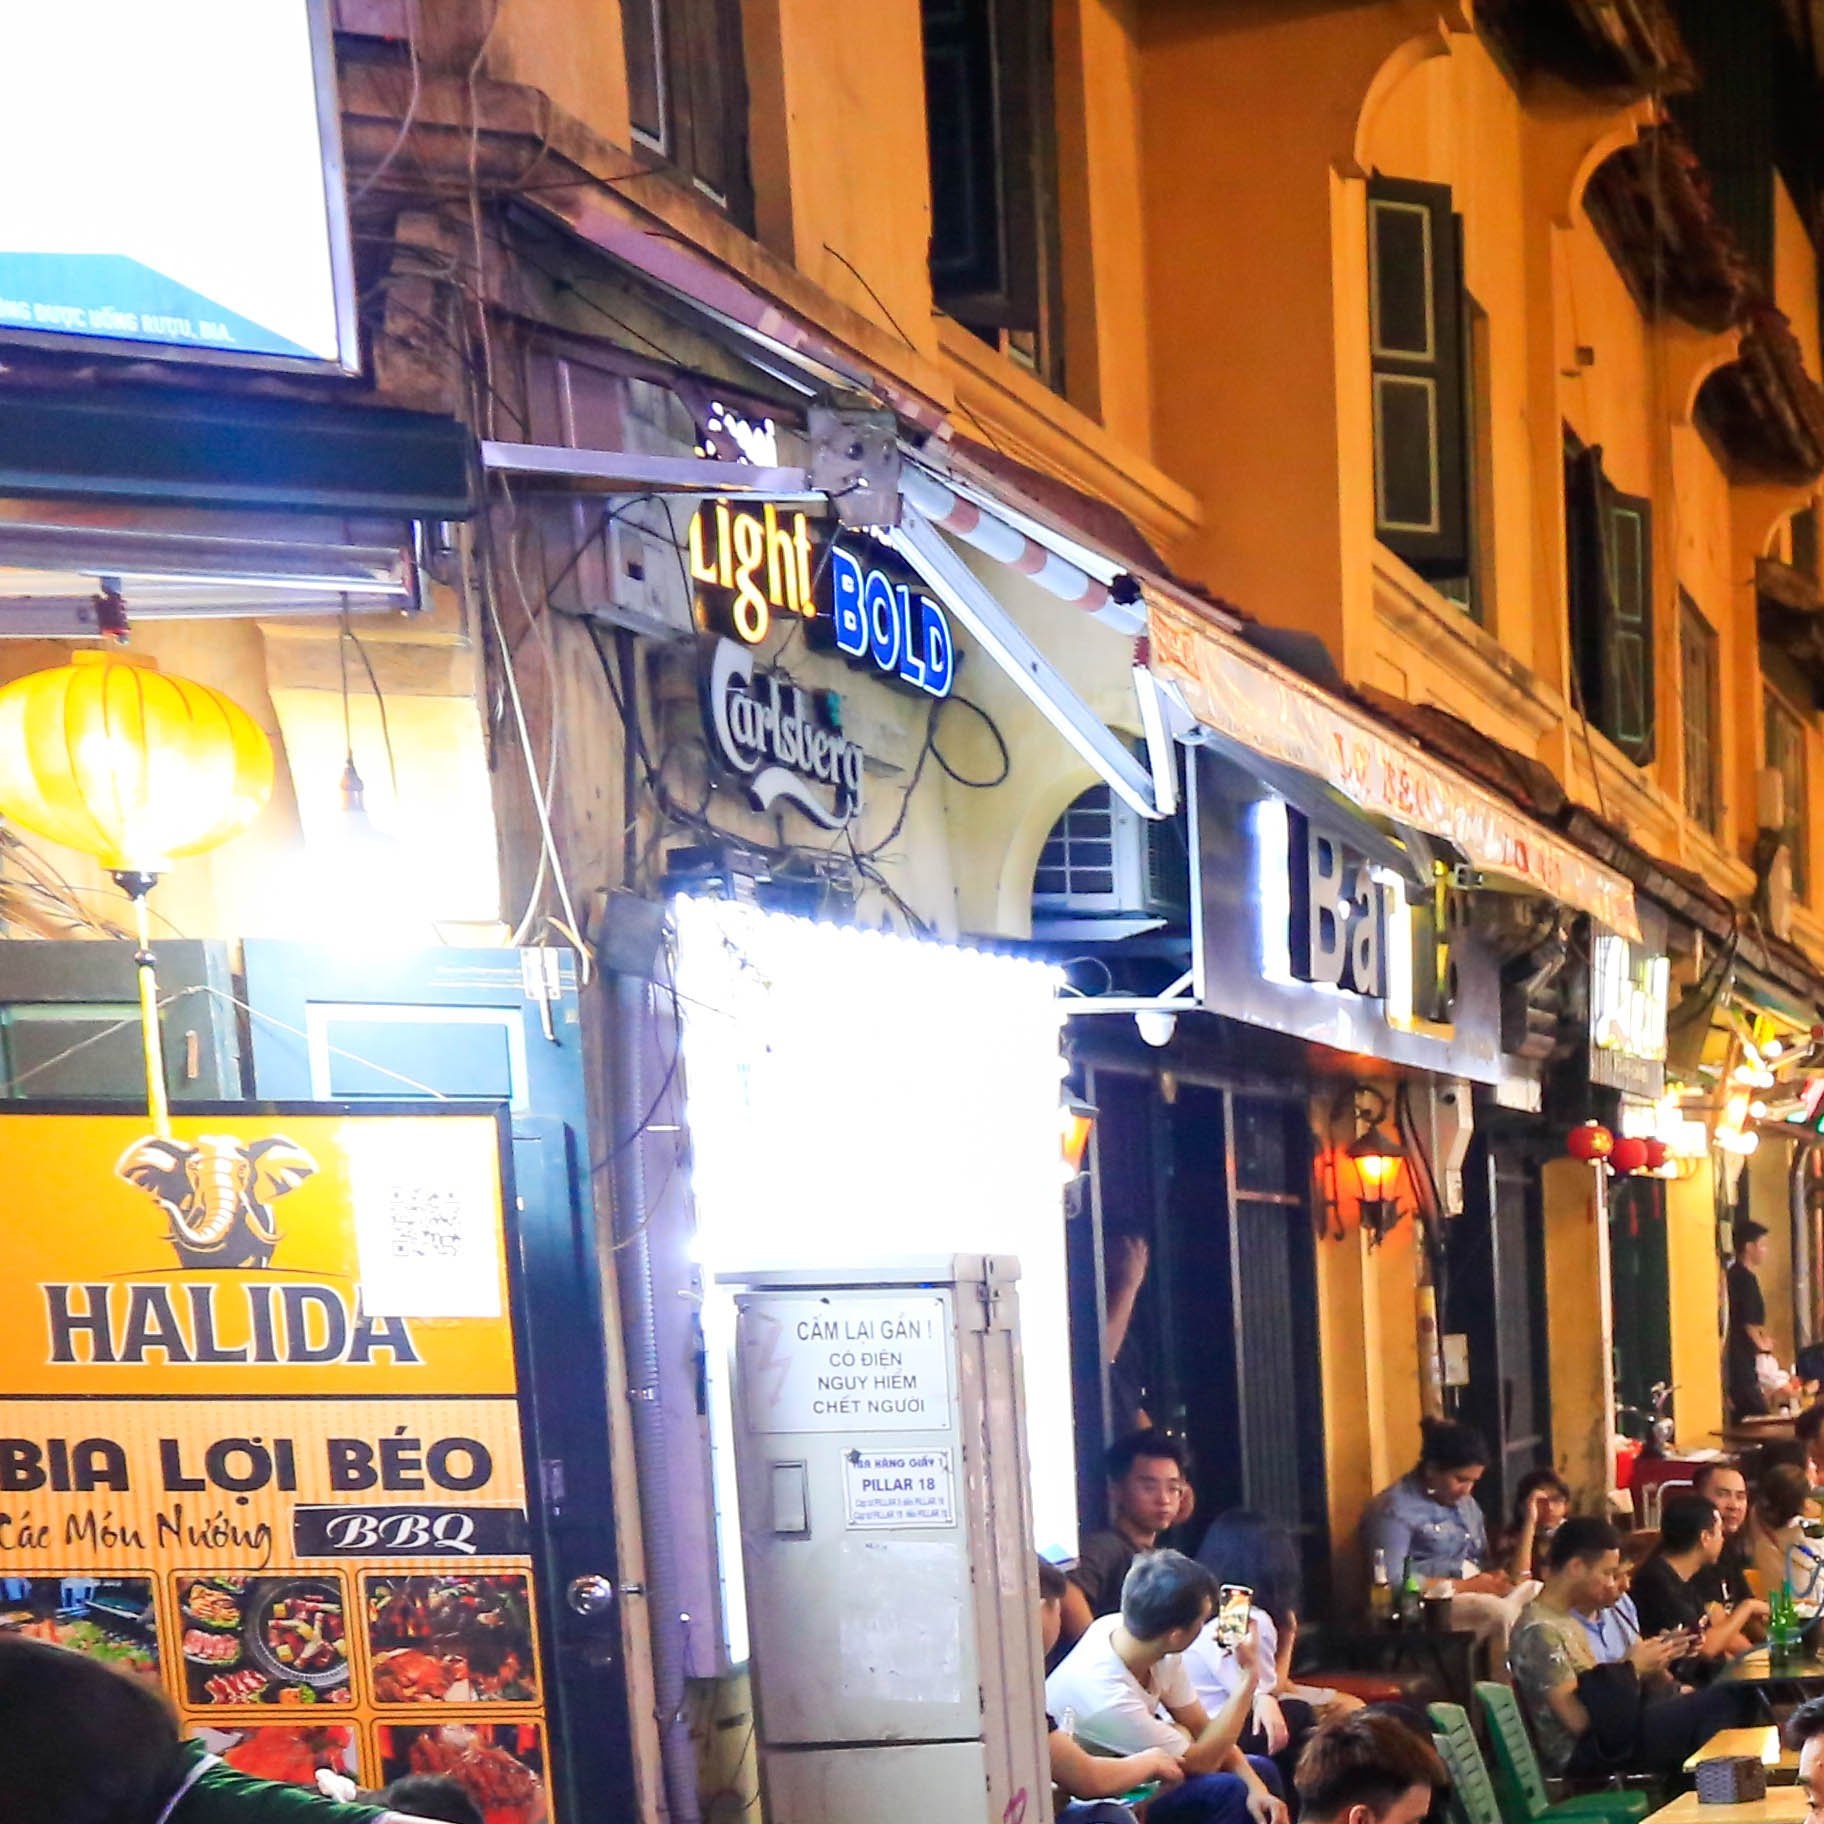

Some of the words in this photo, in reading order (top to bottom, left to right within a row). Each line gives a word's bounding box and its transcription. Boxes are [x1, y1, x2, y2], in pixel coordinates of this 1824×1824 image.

[832, 546, 953, 698] BOLD
[711, 637, 864, 828] Carlsberg
[42, 1283, 424, 1364] HALIDA
[818, 1376, 868, 1390] NGUY
[0, 1438, 129, 1492] BIA
[159, 1436, 297, 1505] LỢI
[327, 1426, 493, 1492] BÉO
[862, 1478, 914, 1492] PILLAR
[919, 1477, 936, 1490] 18
[66, 1508, 145, 1553] Món
[157, 1503, 273, 1569] Nướng
[326, 1514, 478, 1555] BBQ
